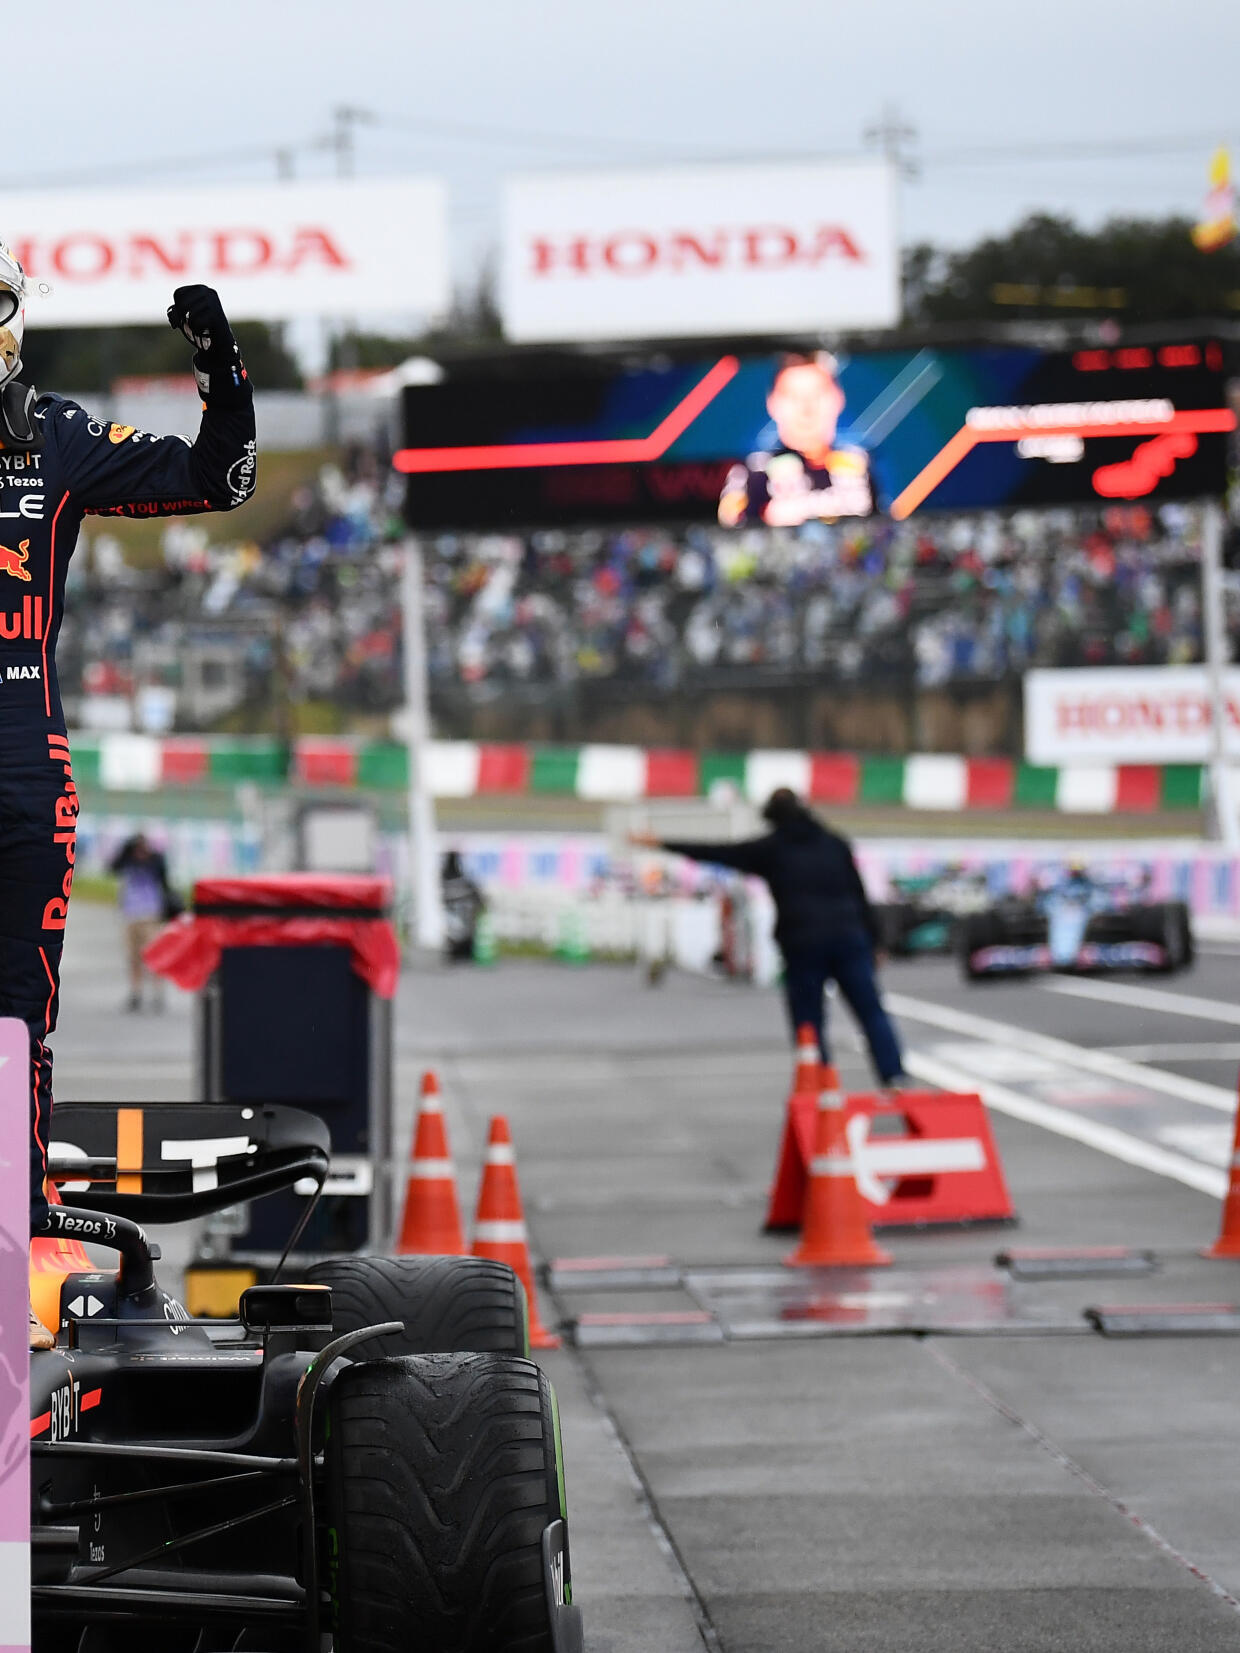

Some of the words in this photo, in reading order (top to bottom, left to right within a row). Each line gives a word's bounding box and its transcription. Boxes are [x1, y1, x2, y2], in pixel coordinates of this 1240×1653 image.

[529, 220, 869, 279] HONDA
[6, 475, 44, 487] Tezos
[128, 502, 159, 515] YOU
[6, 665, 41, 680] MAX
[56, 1211, 101, 1235] Tezos
[51, 1369, 80, 1443] BYBIT
[89, 1541, 105, 1562] Tezos
